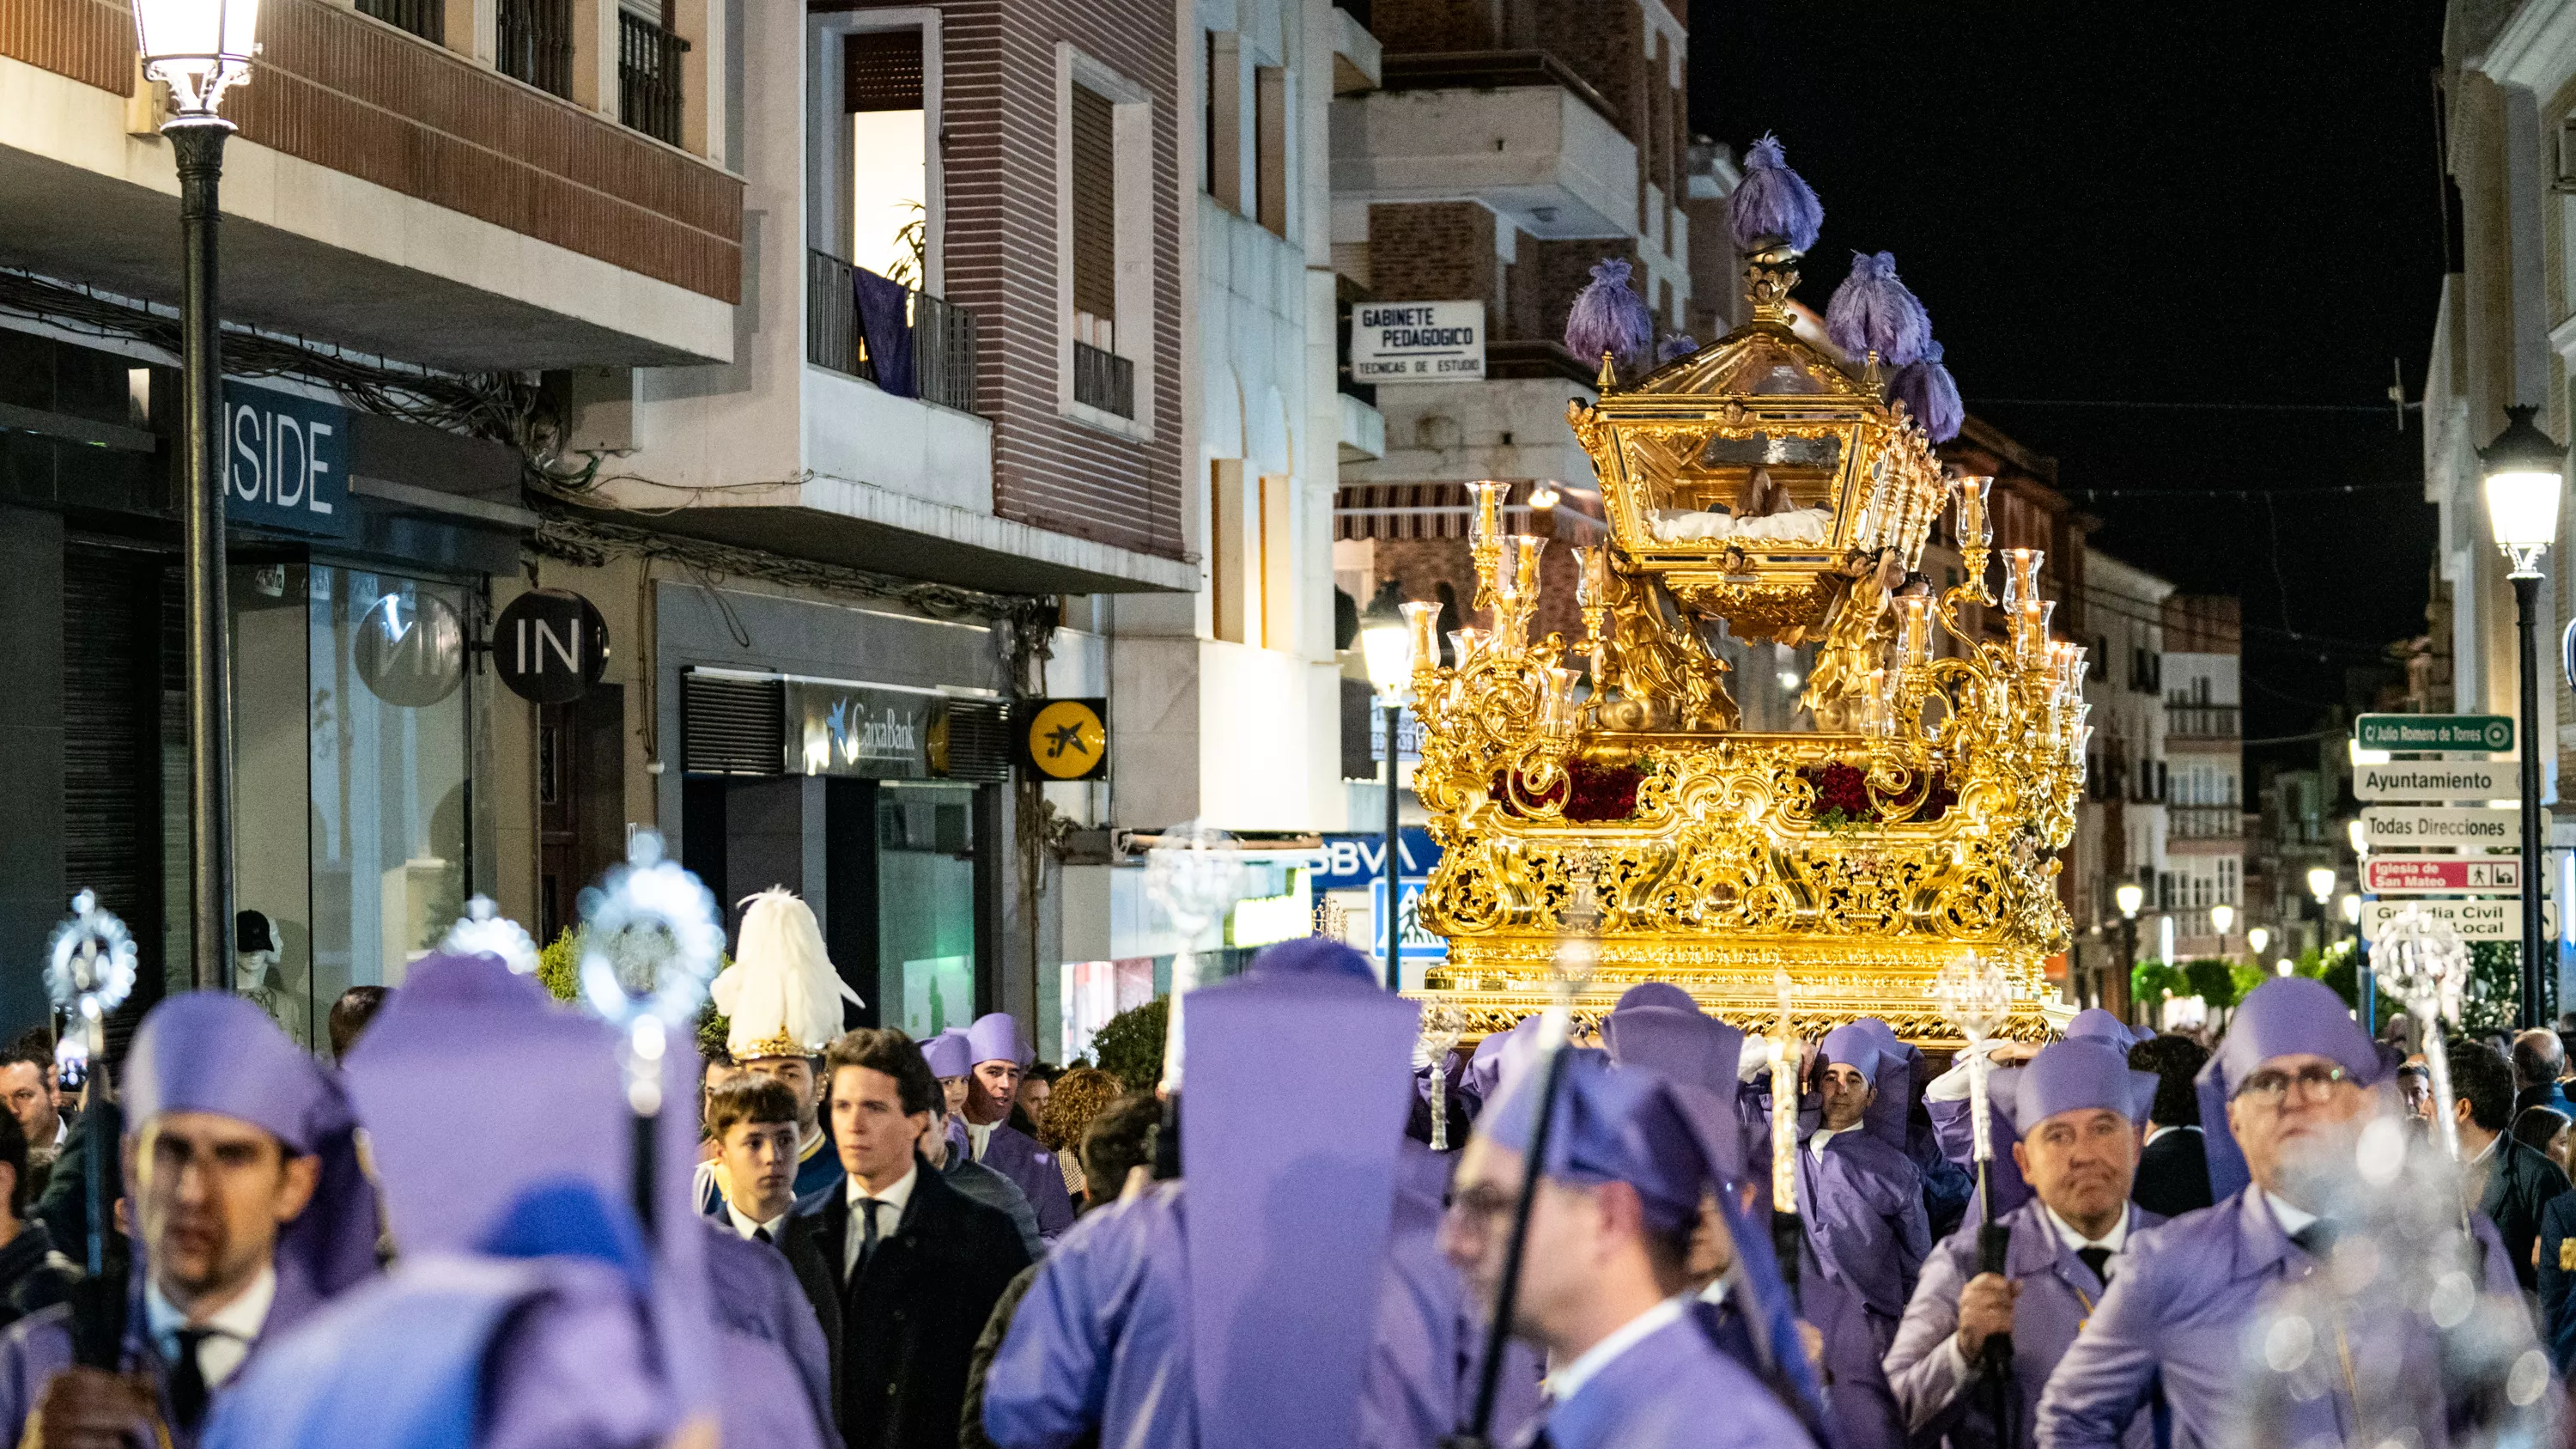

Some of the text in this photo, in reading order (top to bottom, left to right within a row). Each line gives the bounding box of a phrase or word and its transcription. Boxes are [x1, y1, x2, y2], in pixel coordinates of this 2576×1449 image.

[1363, 307, 1434, 326] GABINETE
[1382, 327, 1473, 347] PEDAGOGICO
[1359, 358, 1479, 374] TECNICAS DE ESTUDIO
[223, 402, 332, 514] SIDE
[517, 618, 580, 673] IN
[853, 703, 915, 750] CaixaBank
[2365, 725, 2482, 743] C/ Julio Romero de Torres
[2366, 771, 2492, 791] Ayuntamiento
[2369, 818, 2505, 836] Todas Direcciones
[2375, 861, 2439, 875] Iglesia de
[2375, 874, 2446, 887] San Mateo
[2463, 906, 2504, 919] Civil
[2453, 921, 2504, 934] Local
